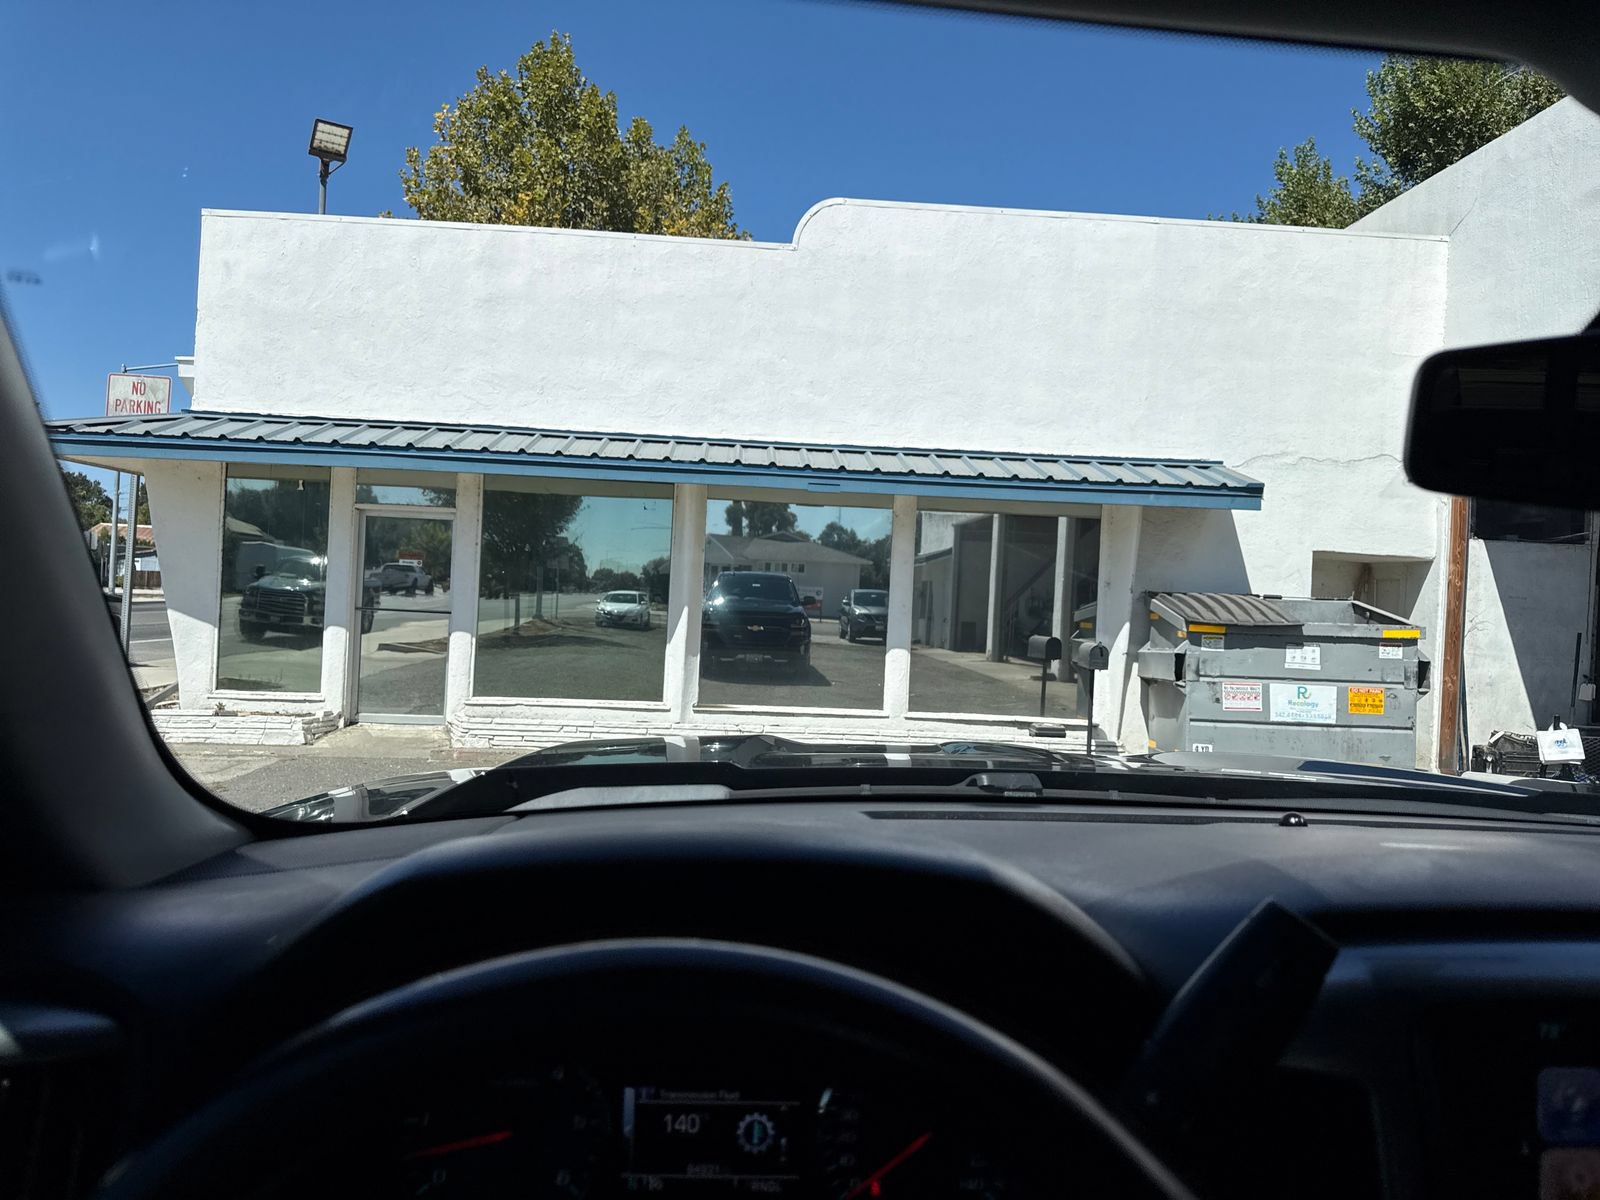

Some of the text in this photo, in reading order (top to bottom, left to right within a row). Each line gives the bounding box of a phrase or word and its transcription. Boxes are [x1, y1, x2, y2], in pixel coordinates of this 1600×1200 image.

[131, 381, 146, 396] NO
[114, 398, 161, 414] PARKING
[1288, 699, 1319, 708] Recology
